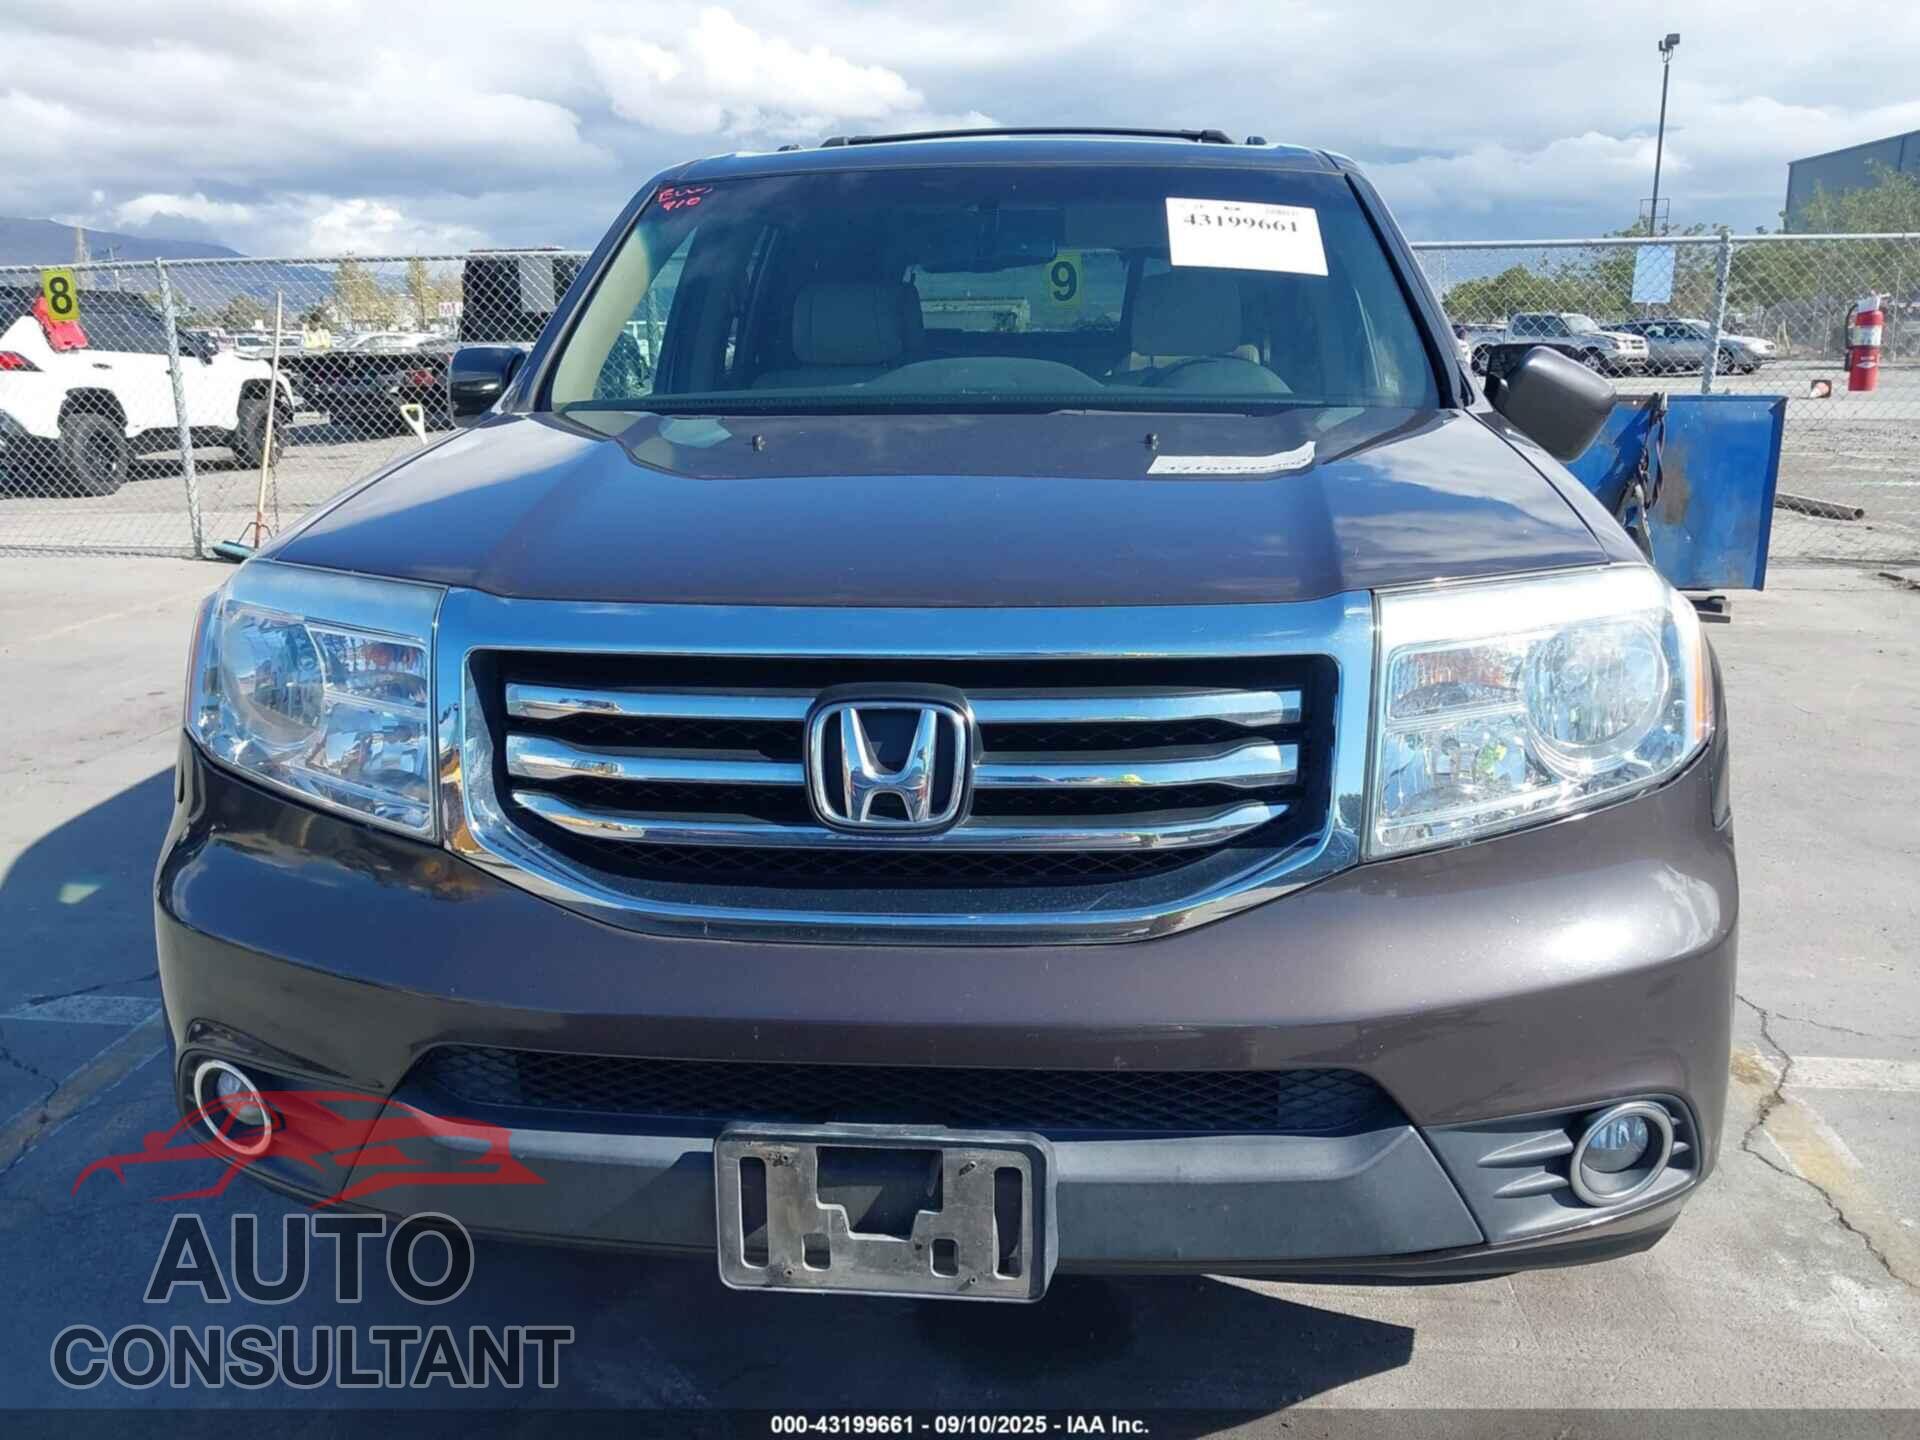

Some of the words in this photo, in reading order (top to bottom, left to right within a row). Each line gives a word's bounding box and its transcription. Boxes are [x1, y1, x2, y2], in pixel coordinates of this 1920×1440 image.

[1183, 213, 1298, 233] 43199661
[49, 276, 73, 315] 8
[1051, 261, 1078, 301] 9
